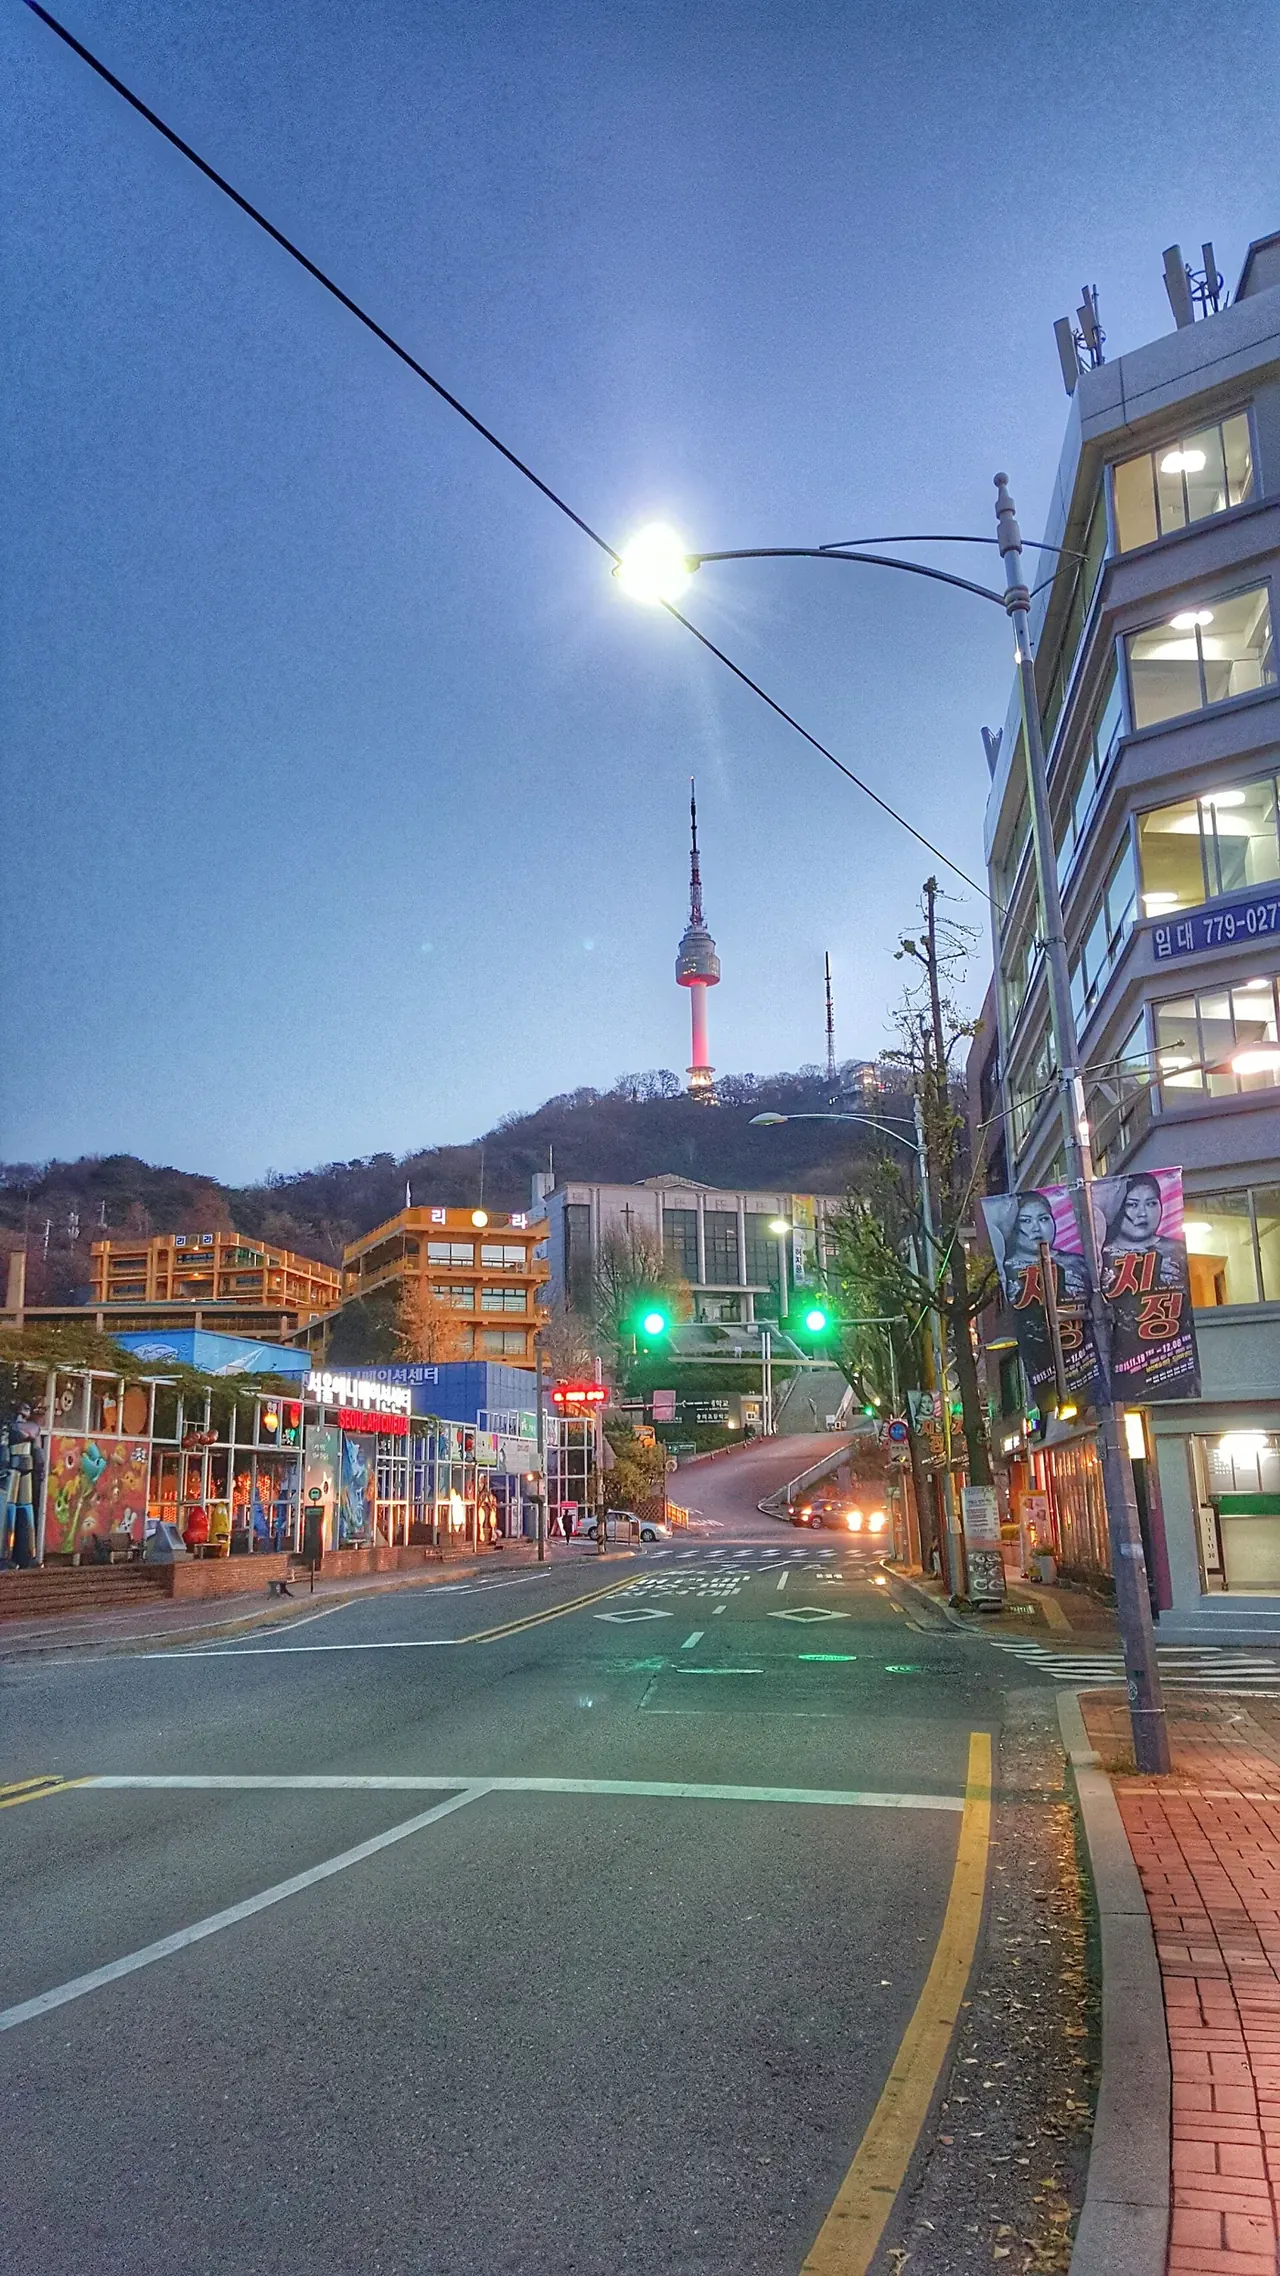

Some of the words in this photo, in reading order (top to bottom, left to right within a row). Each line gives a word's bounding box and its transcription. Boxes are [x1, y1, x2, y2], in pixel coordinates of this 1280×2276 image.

[1155, 921, 1194, 957] 임대
[1203, 902, 1280, 944] 779-027
[431, 1208, 446, 1225] 리
[511, 1213, 529, 1230] 라
[1106, 1251, 1156, 1299] 치
[1135, 1293, 1182, 1340] 정
[339, 1408, 368, 1432] SEOUL
[381, 1415, 409, 1435] CINEMA
